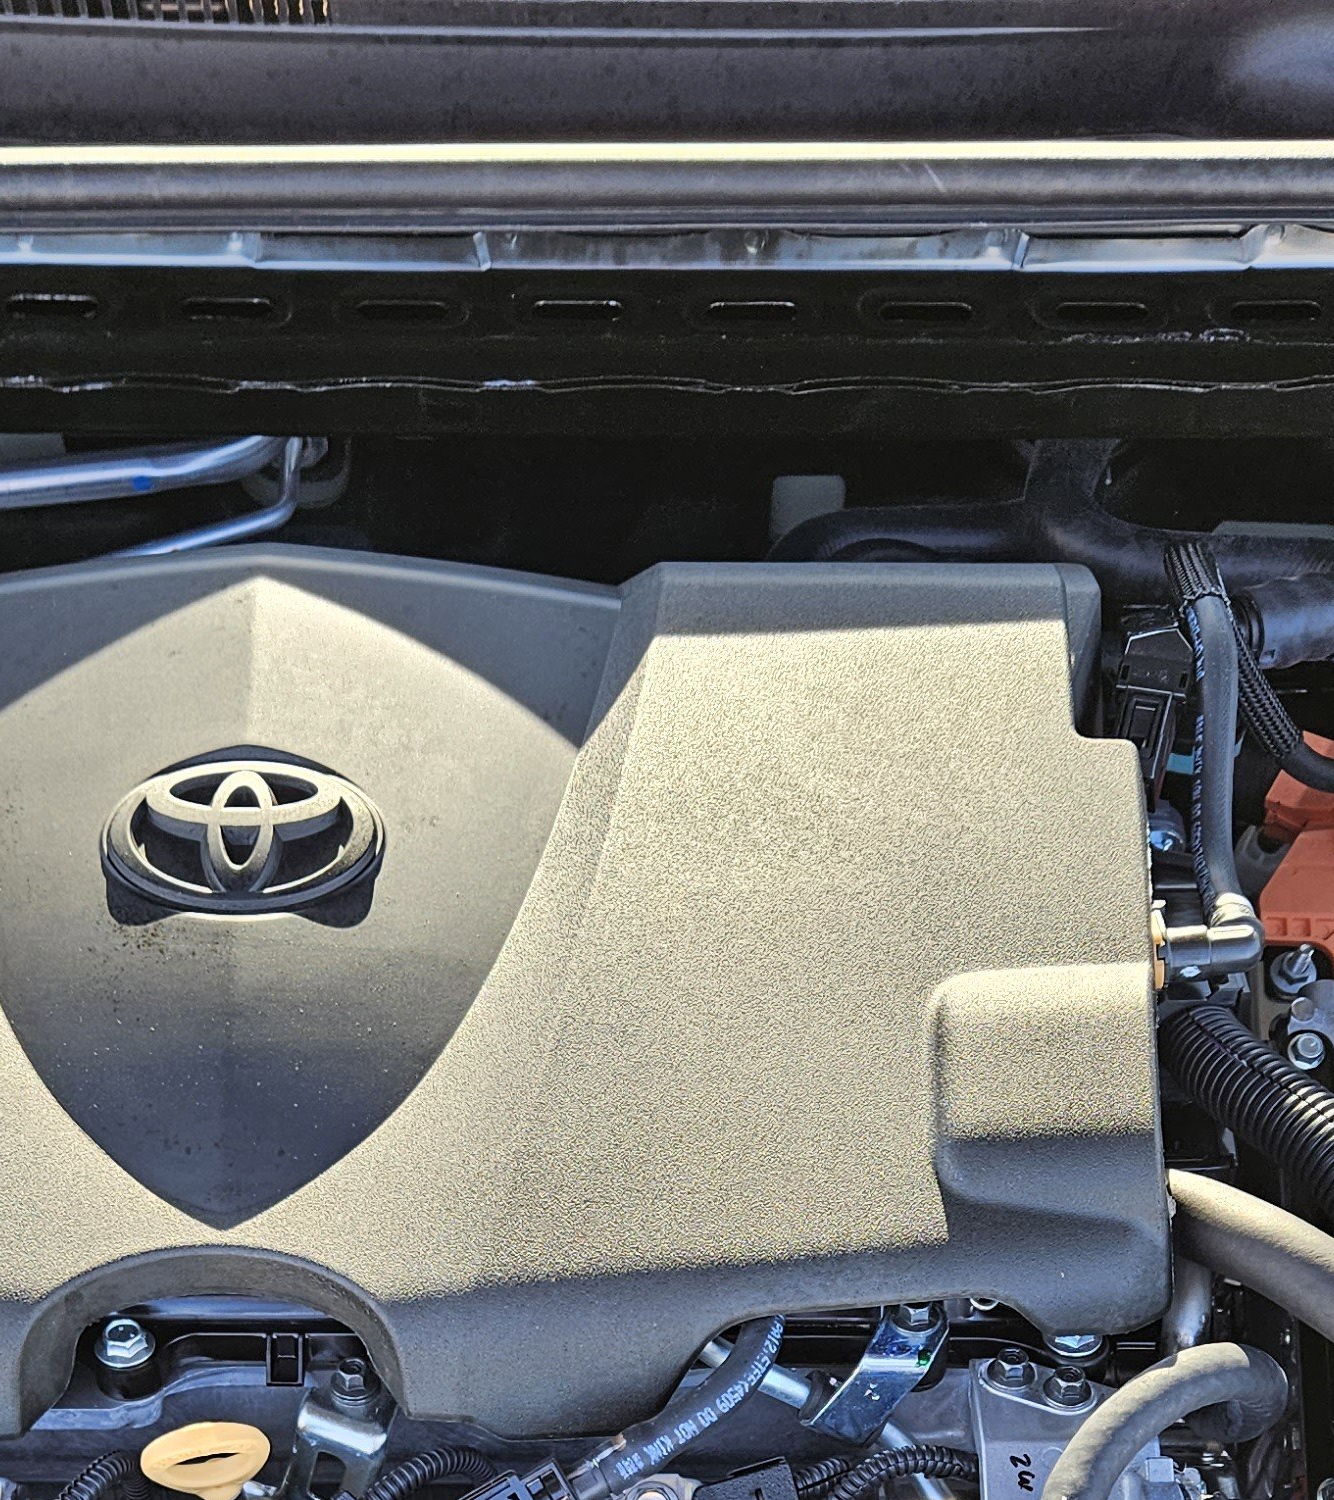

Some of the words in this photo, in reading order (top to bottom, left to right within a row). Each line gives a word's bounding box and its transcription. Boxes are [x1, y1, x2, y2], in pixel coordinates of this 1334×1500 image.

[697, 1407, 719, 1427] DO
[673, 1420, 699, 1445] NOT
[643, 1435, 674, 1465] KINK
